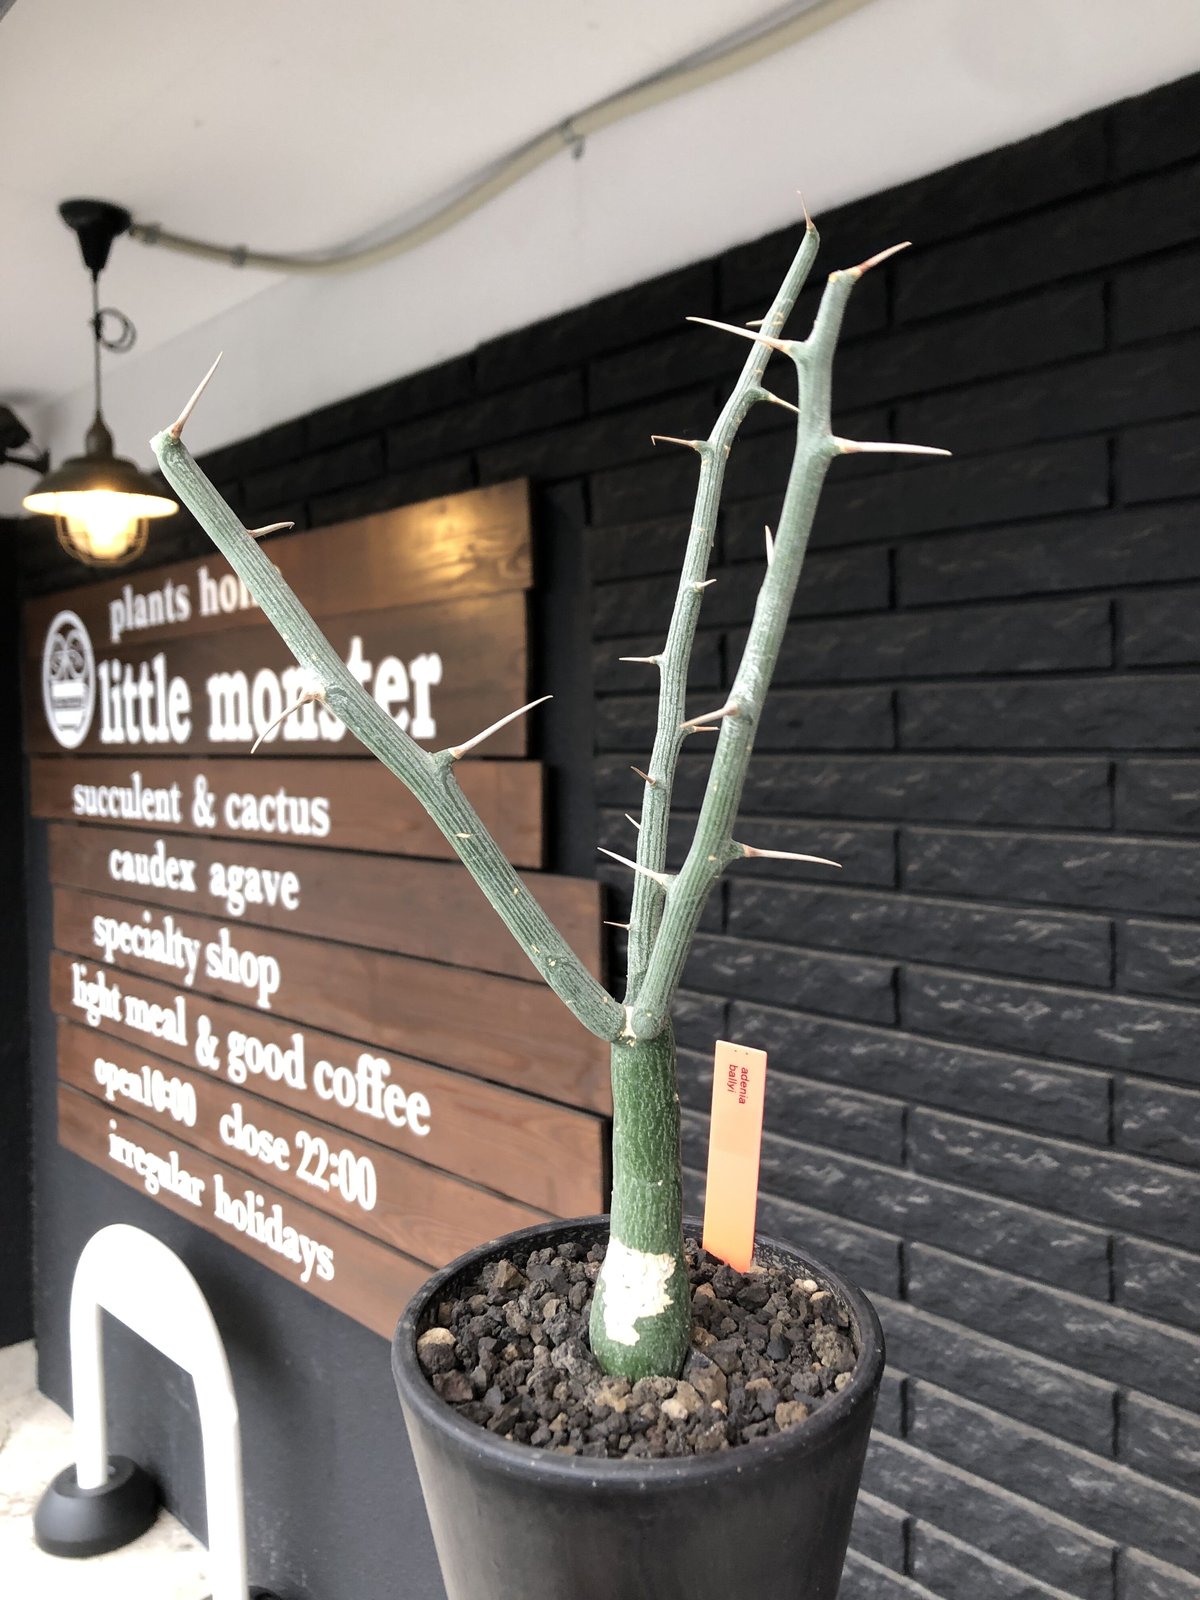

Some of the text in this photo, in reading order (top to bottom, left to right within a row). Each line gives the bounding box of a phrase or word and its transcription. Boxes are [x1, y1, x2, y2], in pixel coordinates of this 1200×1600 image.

[108, 566, 281, 643] plants ho
[99, 652, 192, 744] little
[72, 771, 331, 836] succulent & cactus
[109, 839, 300, 916] caudex agave
[93, 911, 281, 1009] specialty shop
[71, 962, 432, 1136] light meal & good coffee
[727, 1064, 738, 1093] ballyi
[738, 1067, 749, 1104] adenia
[219, 1103, 291, 1171] close
[295, 1130, 378, 1211] 22:00
[108, 1119, 335, 1283] irregular holidays
